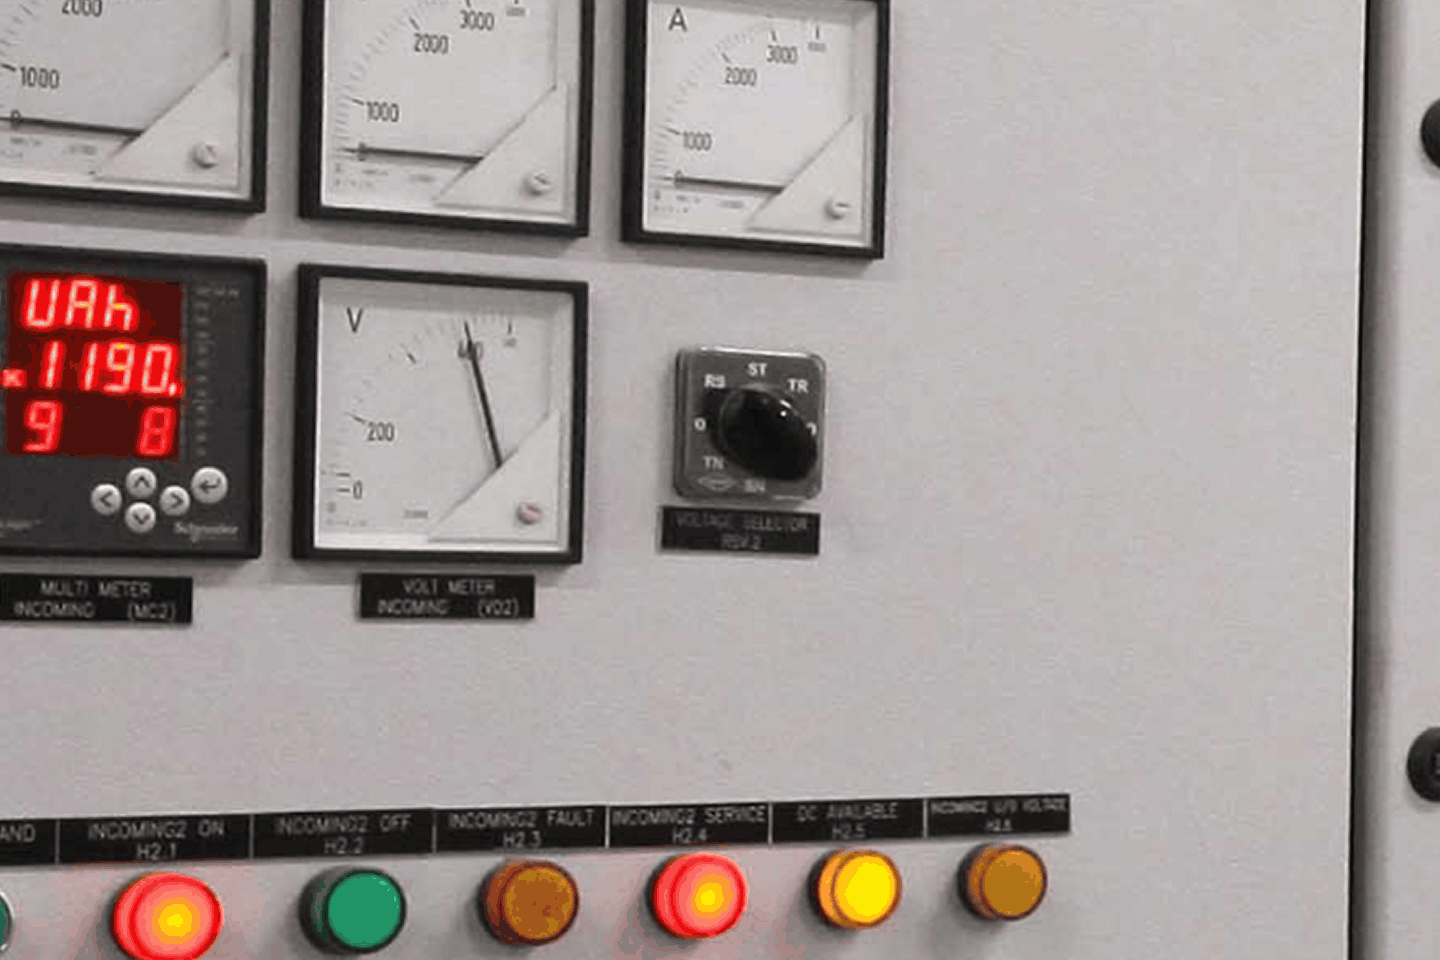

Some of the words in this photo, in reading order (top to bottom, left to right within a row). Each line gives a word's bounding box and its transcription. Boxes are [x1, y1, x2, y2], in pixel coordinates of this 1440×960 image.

[460, 9, 495, 31] 3000
[668, 7, 688, 32] A
[414, 32, 450, 55] 2000
[19, 65, 60, 90] 1000
[724, 66, 757, 86] 2000
[366, 101, 400, 123] 1000
[682, 130, 712, 151] 1000
[347, 305, 364, 333] V
[748, 362, 768, 377] ST
[788, 378, 809, 394] TR
[21, 399, 62, 453] 9
[137, 404, 175, 457] 8
[367, 422, 396, 442] 200
[40, 579, 90, 597] MULTI
[97, 580, 153, 599] METER
[448, 578, 496, 597] METER
[13, 602, 97, 619] INCOMING
[379, 813, 412, 833] OFF
[546, 808, 595, 827] FAULT
[704, 804, 767, 824] SERVICE
[87, 819, 187, 842] INCOMING2
[197, 818, 226, 837] ON
